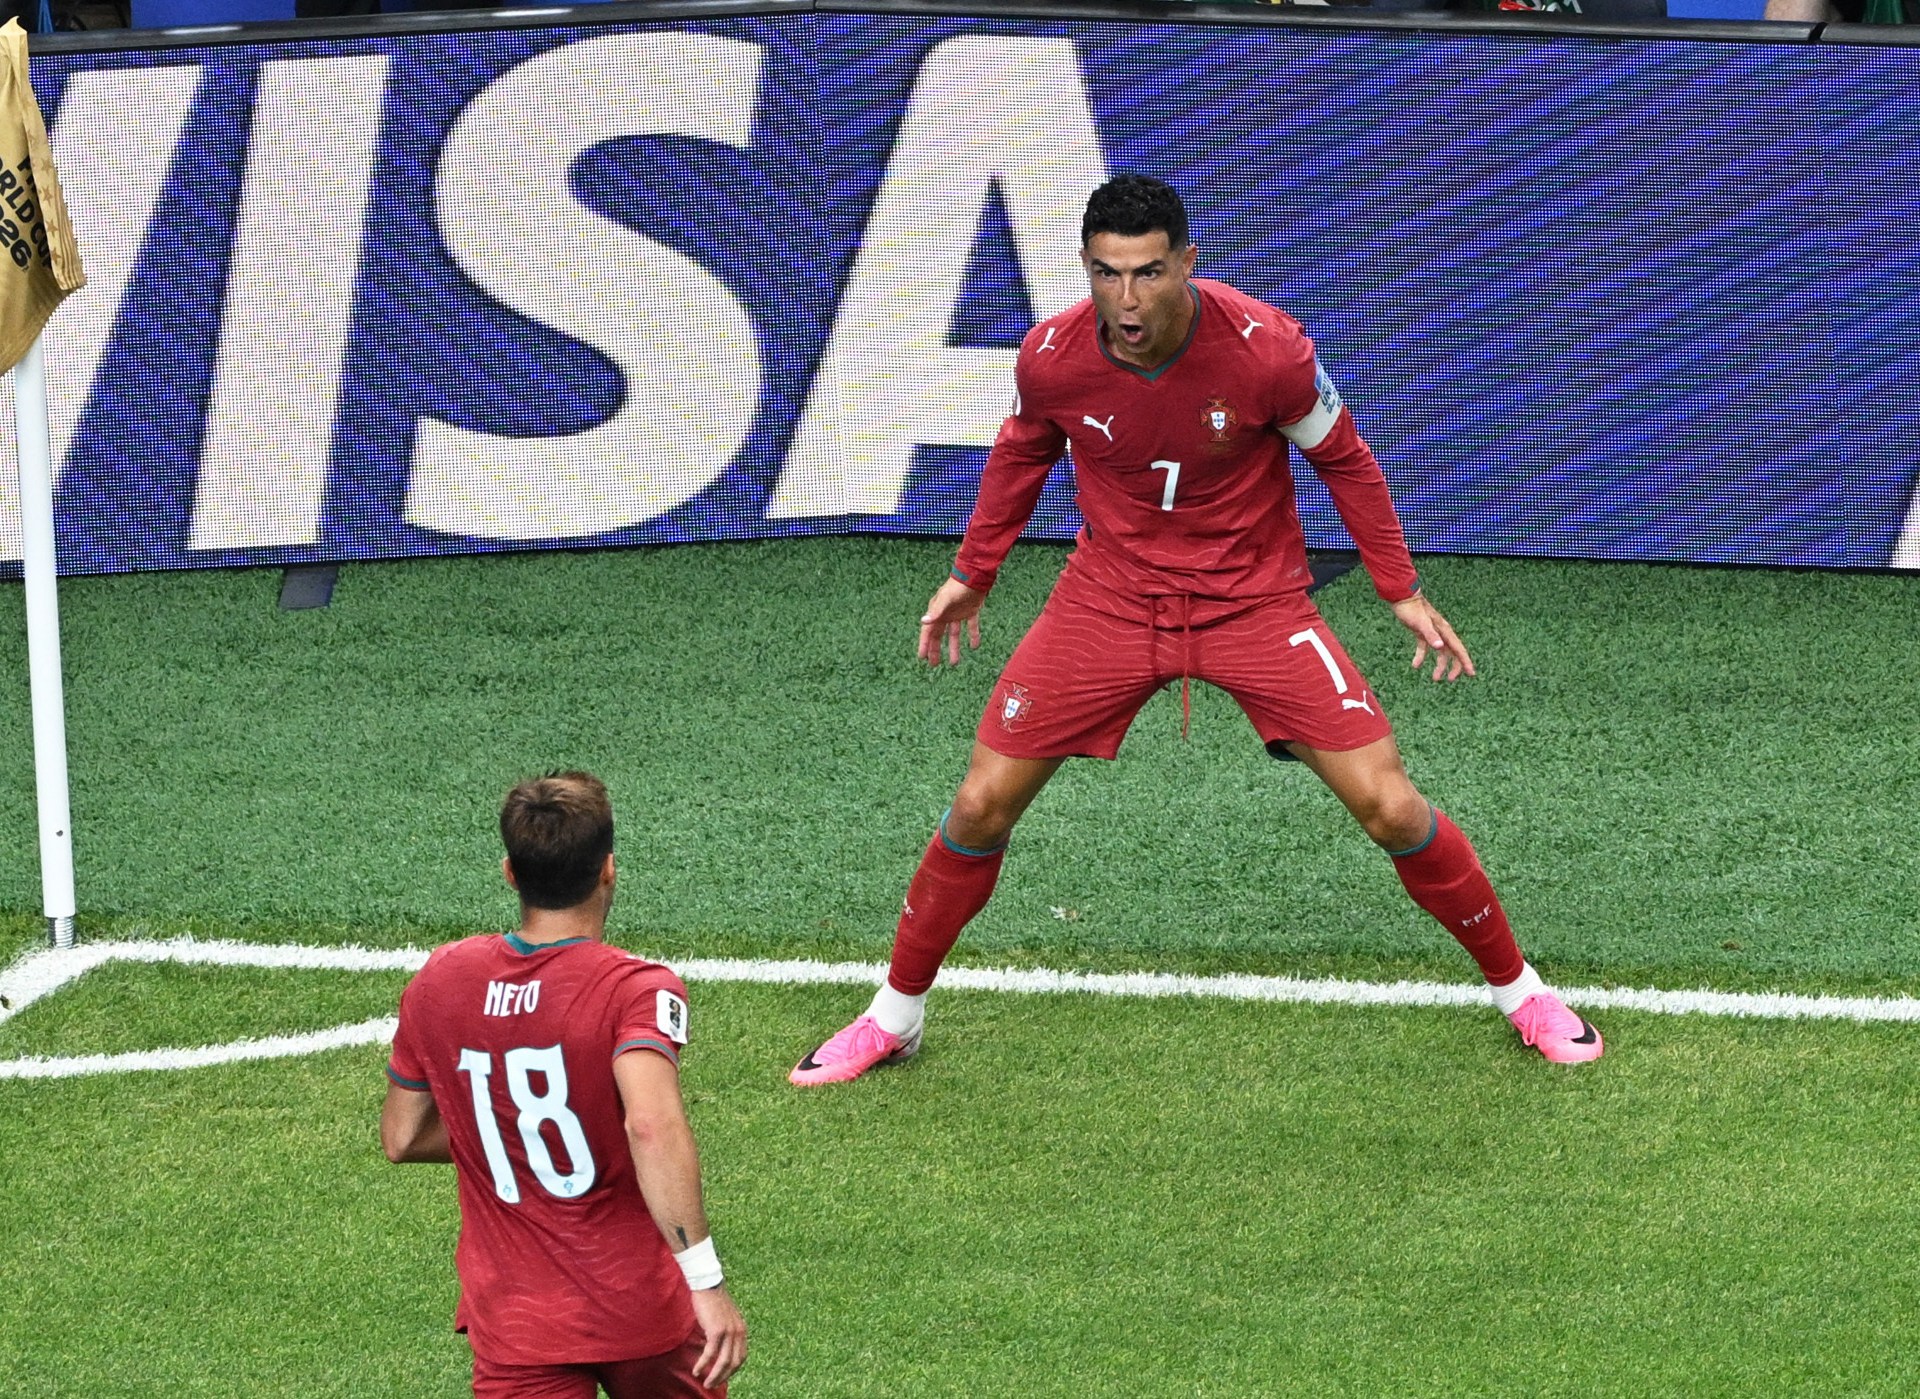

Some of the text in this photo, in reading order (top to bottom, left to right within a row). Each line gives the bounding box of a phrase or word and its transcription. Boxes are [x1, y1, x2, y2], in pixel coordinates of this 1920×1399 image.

[0, 157, 35, 223] RLD
[1151, 460, 1181, 511] 7
[1289, 628, 1348, 694] 7
[484, 980, 541, 1017] NETO
[456, 1044, 596, 1204] 18
